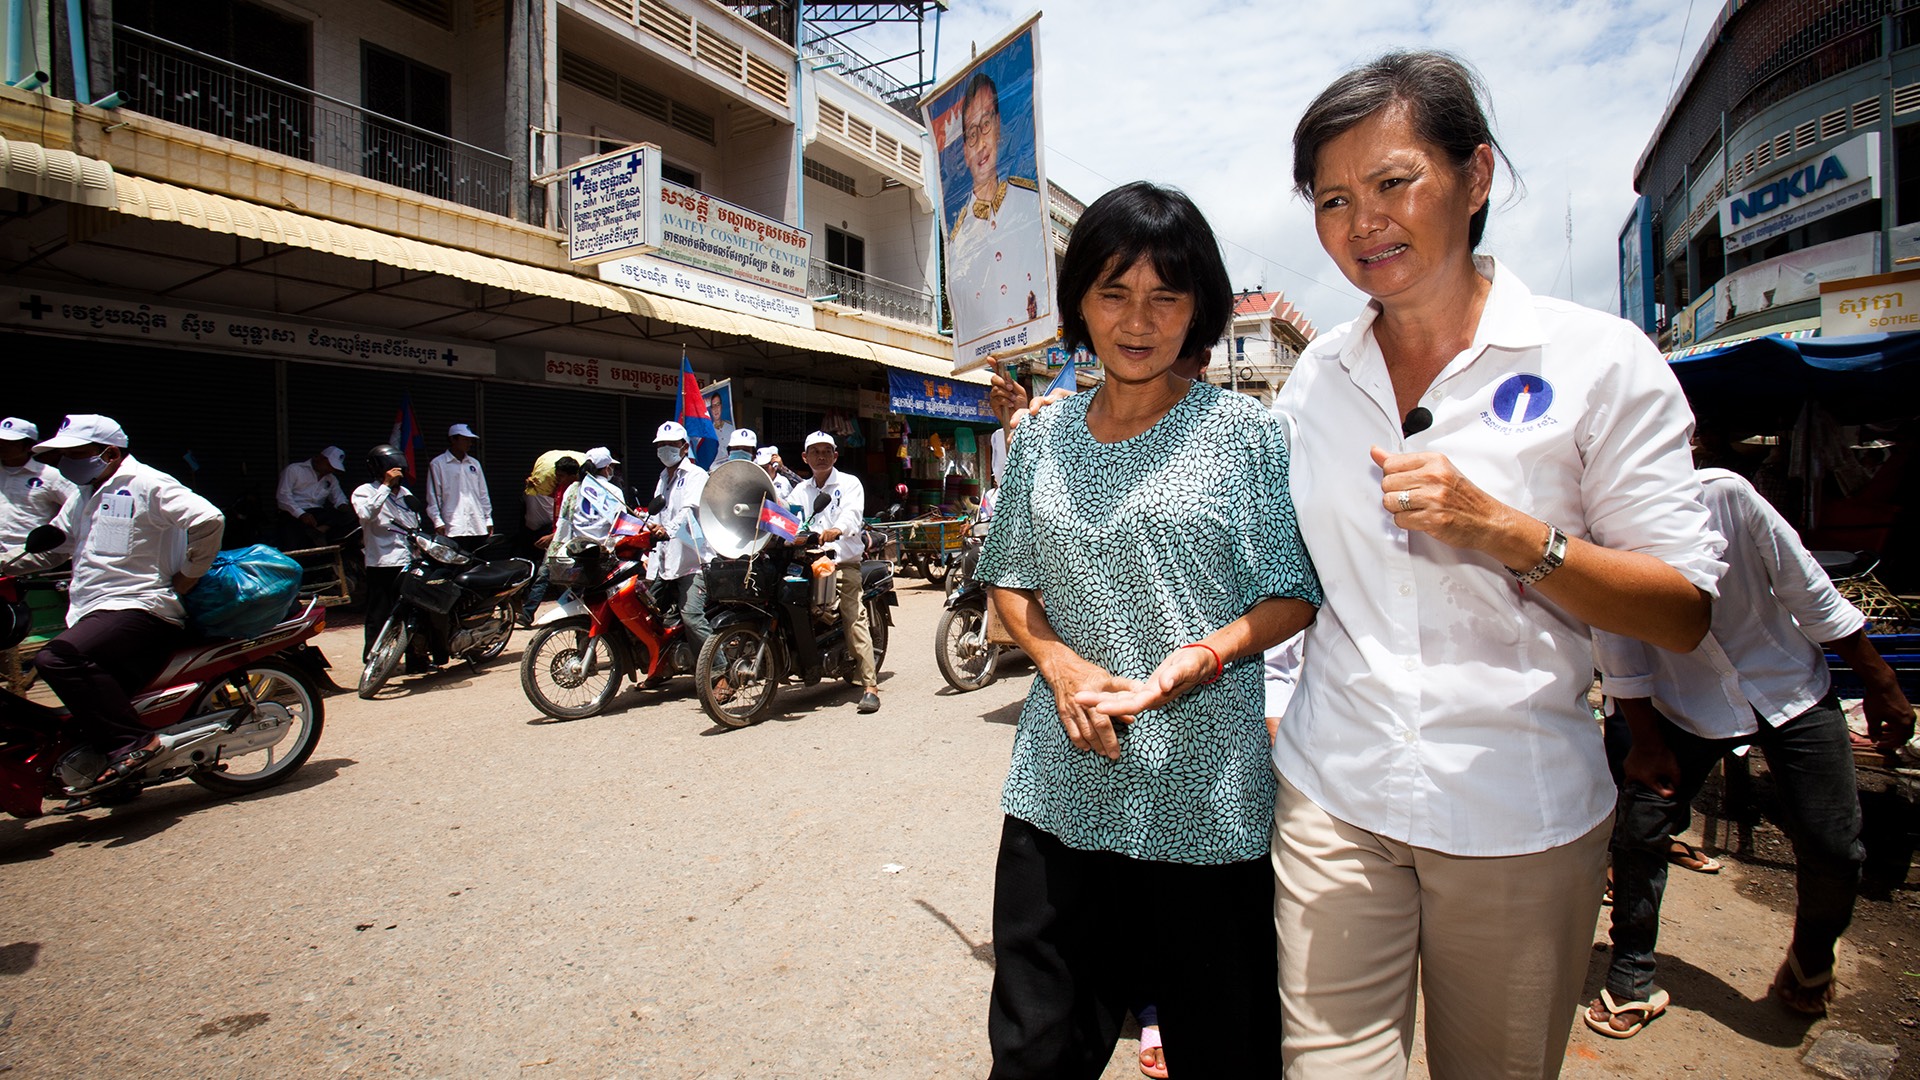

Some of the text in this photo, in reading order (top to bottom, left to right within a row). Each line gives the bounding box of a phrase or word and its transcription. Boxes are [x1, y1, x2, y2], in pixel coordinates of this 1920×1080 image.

[583, 197, 597, 209] SIM
[600, 187, 641, 203] YUTHEASA
[660, 187, 710, 223] សាវត្តី
[1731, 155, 1848, 226] NOKIA
[660, 213, 807, 268] AVATEY COSMETIC CENTER
[62, 304, 438, 364] វេជ្ជបណ្ឌិត ស៊ីម យុទ្ធាសា ជំនាញផ្នែកជំងឺស្បែក
[1869, 314, 1920, 327] SOTHE
[1003, 335, 1016, 347] សម
[546, 358, 599, 385] សាវត្តី
